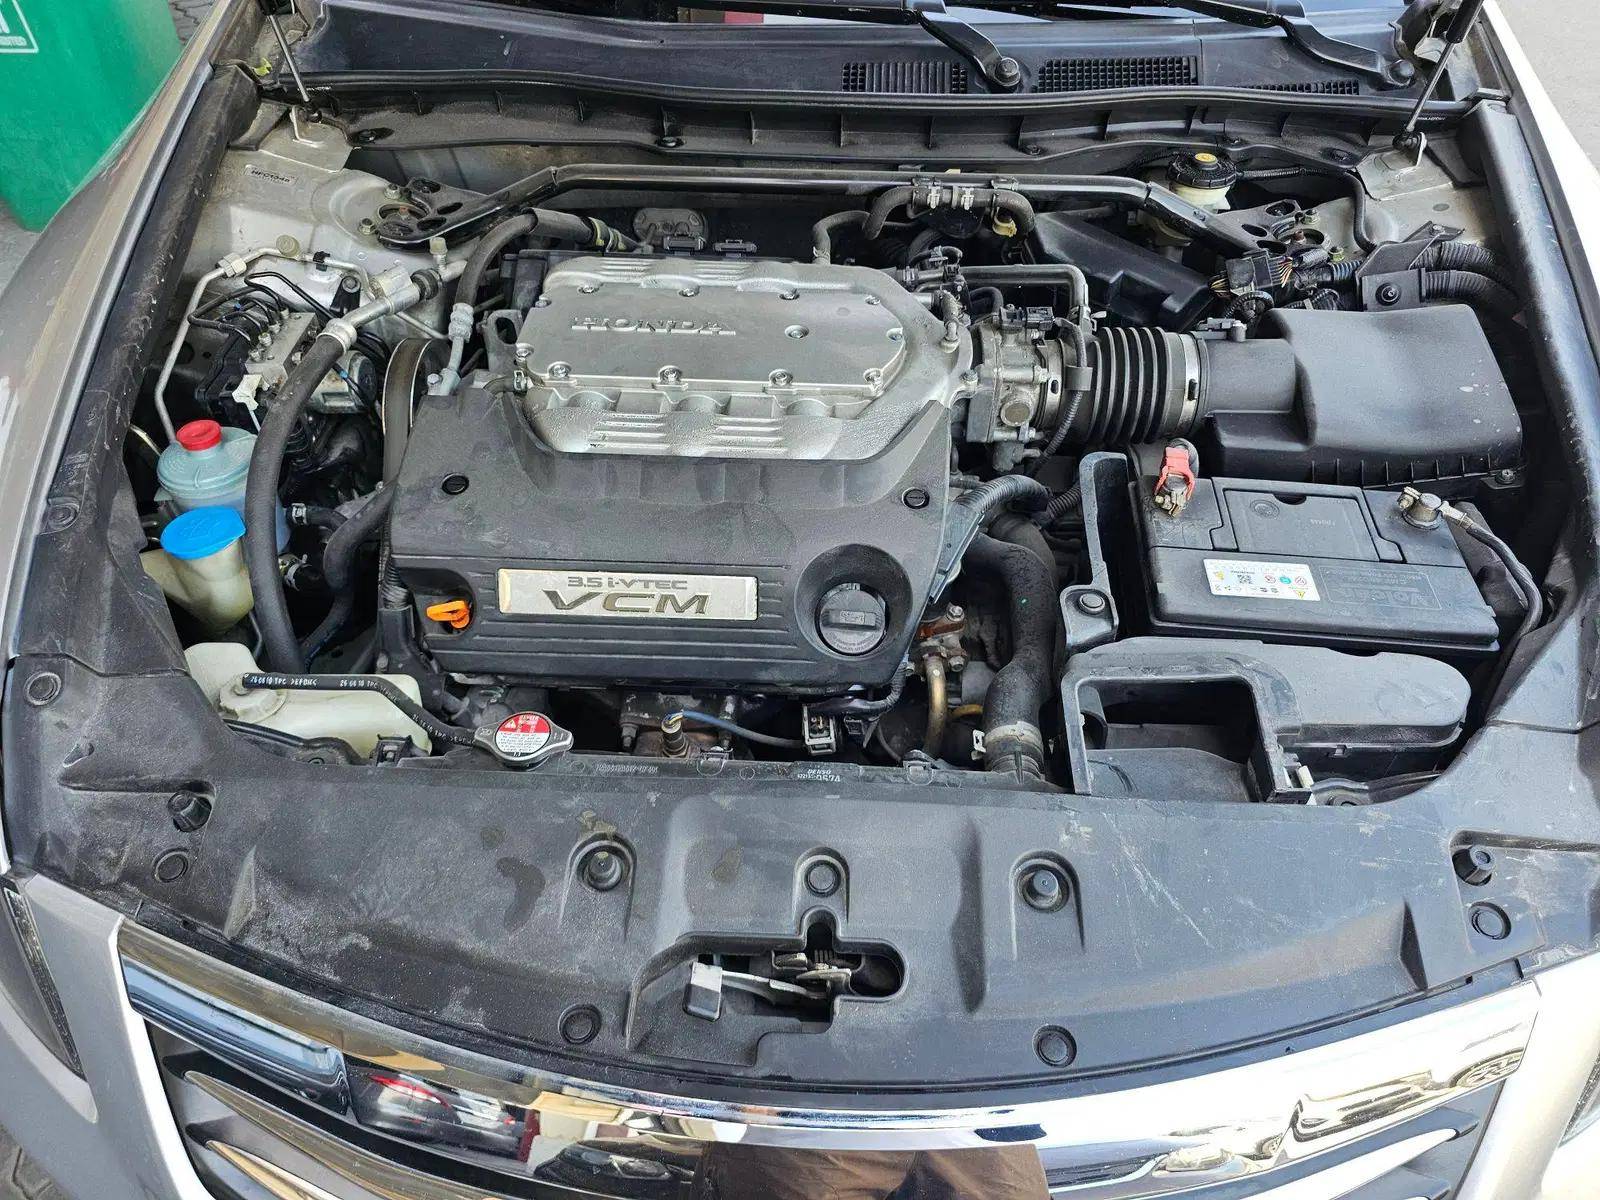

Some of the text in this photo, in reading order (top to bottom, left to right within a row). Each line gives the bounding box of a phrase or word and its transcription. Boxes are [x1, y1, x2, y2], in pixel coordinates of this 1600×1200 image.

[571, 316, 736, 336] HONDA
[568, 576, 602, 589] 3.5
[543, 589, 711, 615] VCM
